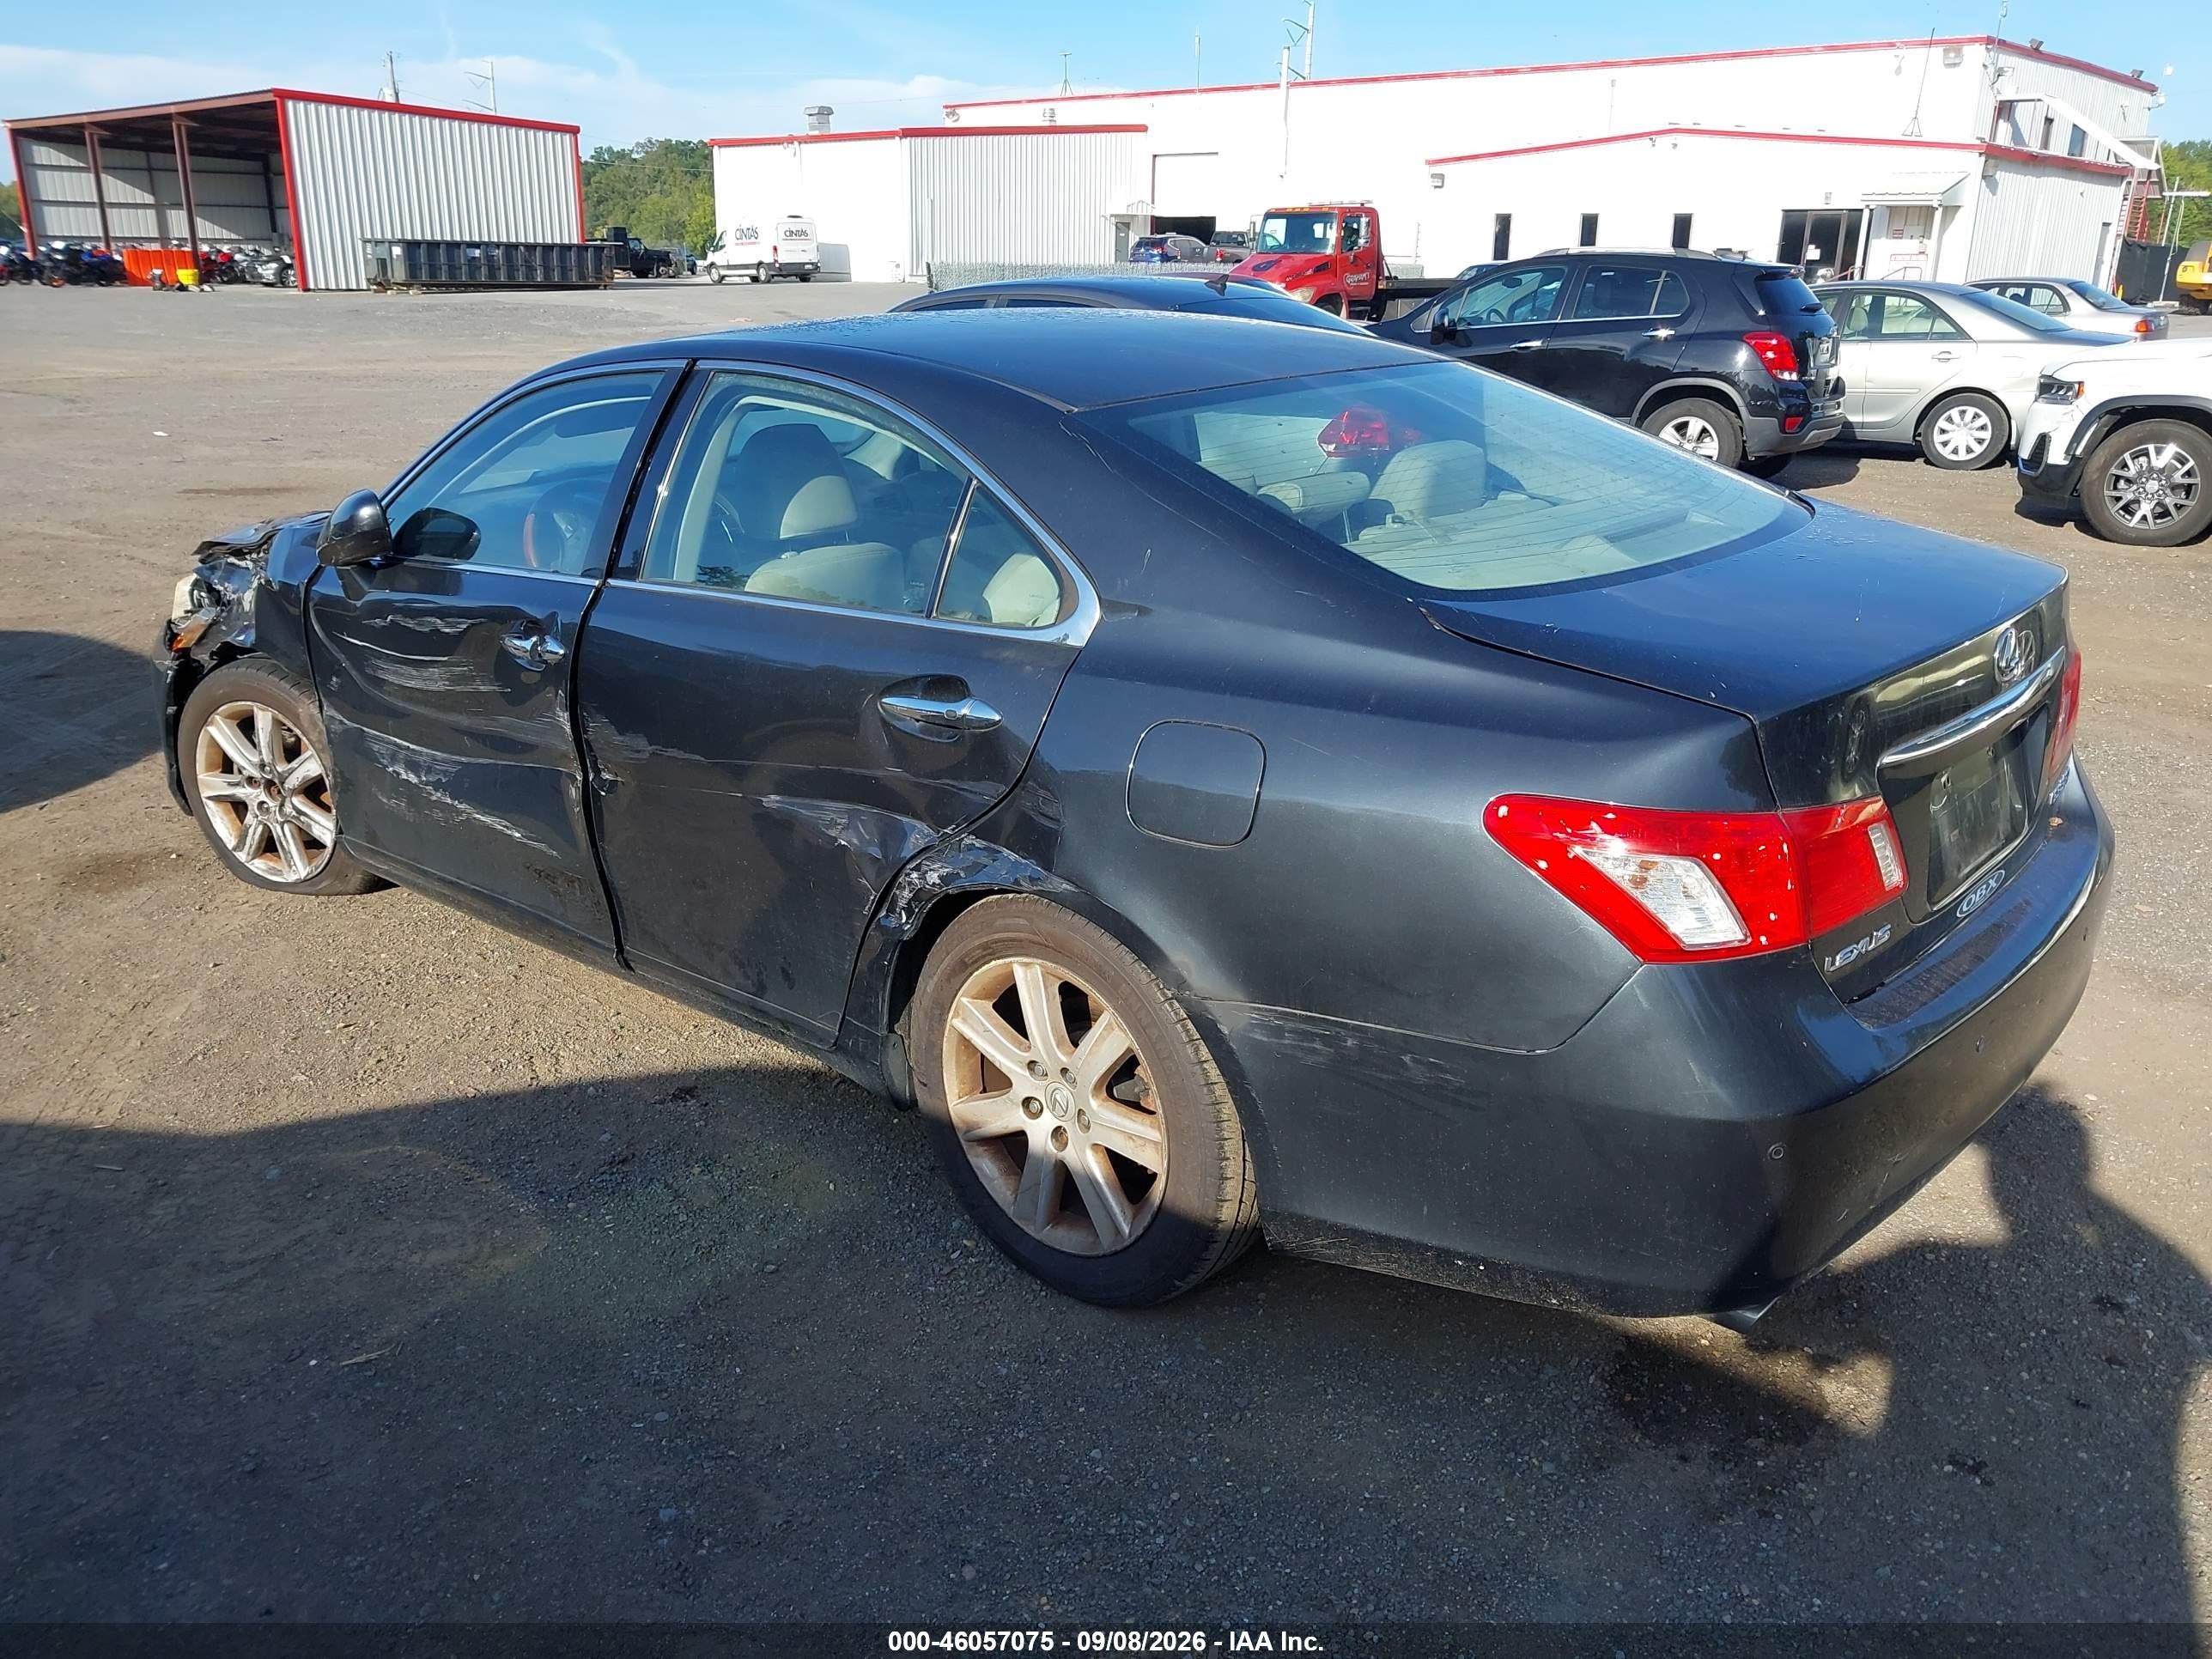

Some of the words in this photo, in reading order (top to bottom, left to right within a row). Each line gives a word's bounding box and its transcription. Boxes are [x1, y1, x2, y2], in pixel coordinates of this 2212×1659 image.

[735, 224, 759, 241] CINTAS
[784, 228, 809, 238] CINTAS
[1962, 872, 1999, 912] OBX
[1824, 923, 1892, 973] LEXUS
